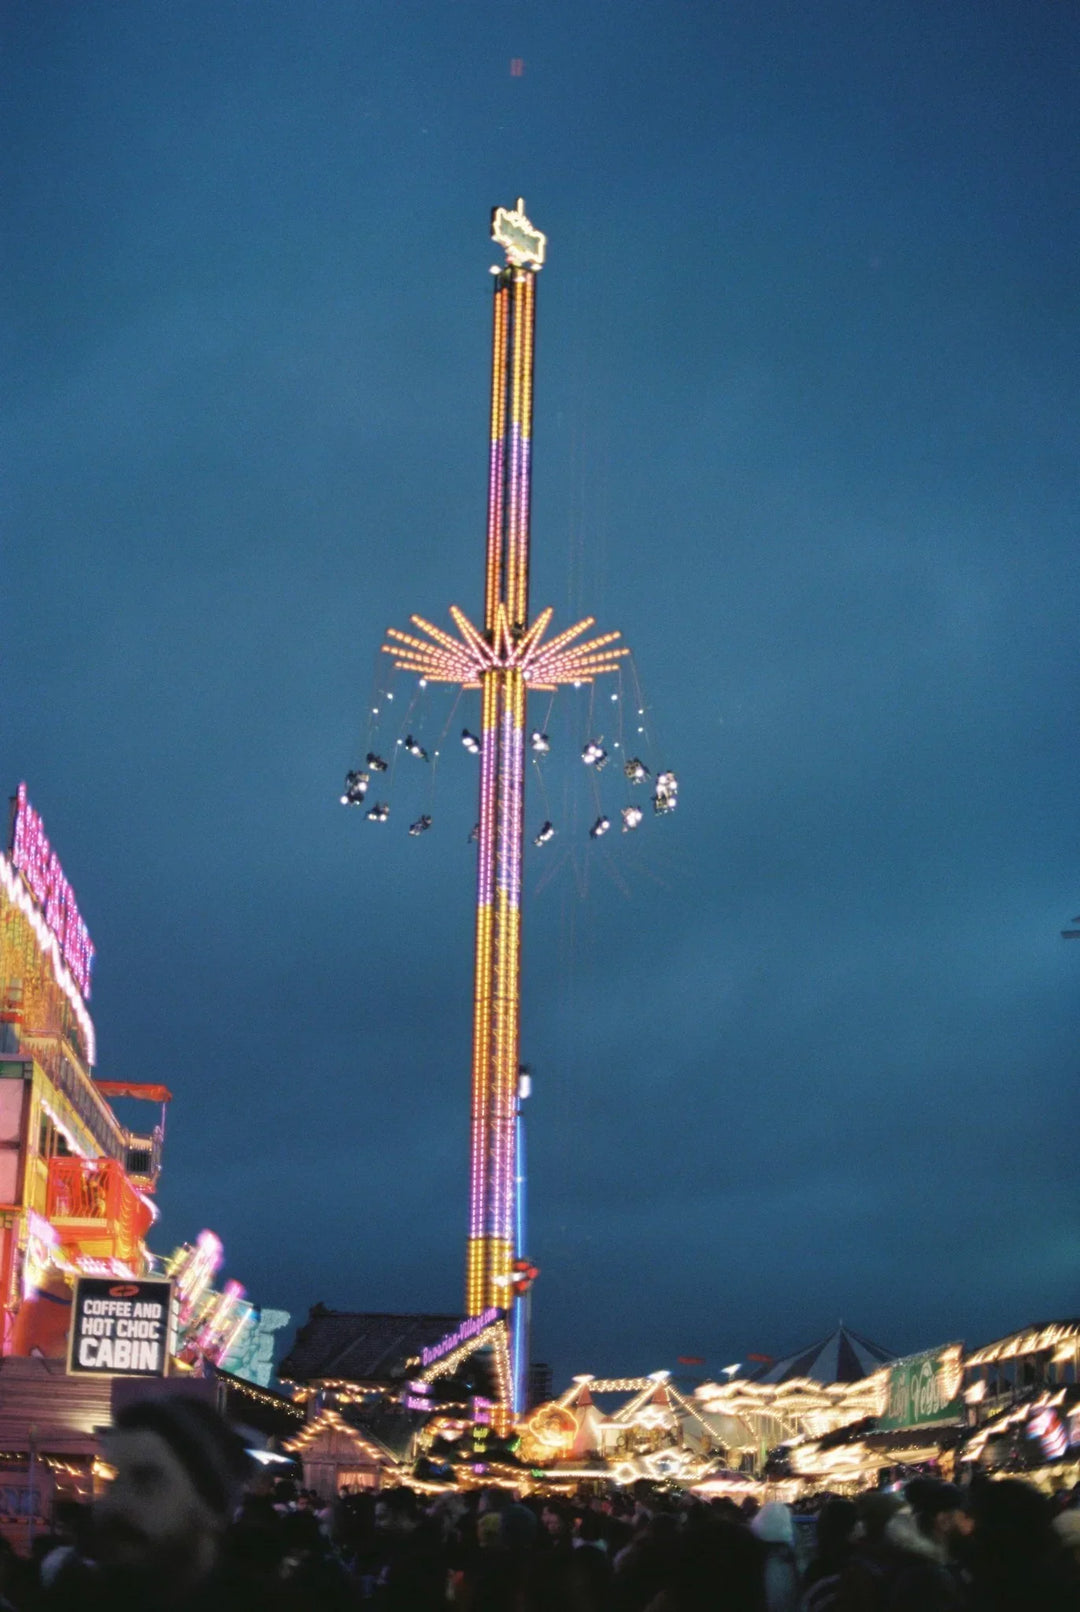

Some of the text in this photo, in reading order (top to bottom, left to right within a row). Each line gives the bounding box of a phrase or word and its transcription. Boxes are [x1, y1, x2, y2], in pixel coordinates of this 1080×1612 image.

[83, 1299, 162, 1319] COFFEE AND
[81, 1317, 160, 1340] HOT CHOC
[78, 1337, 160, 1371] CABIN
